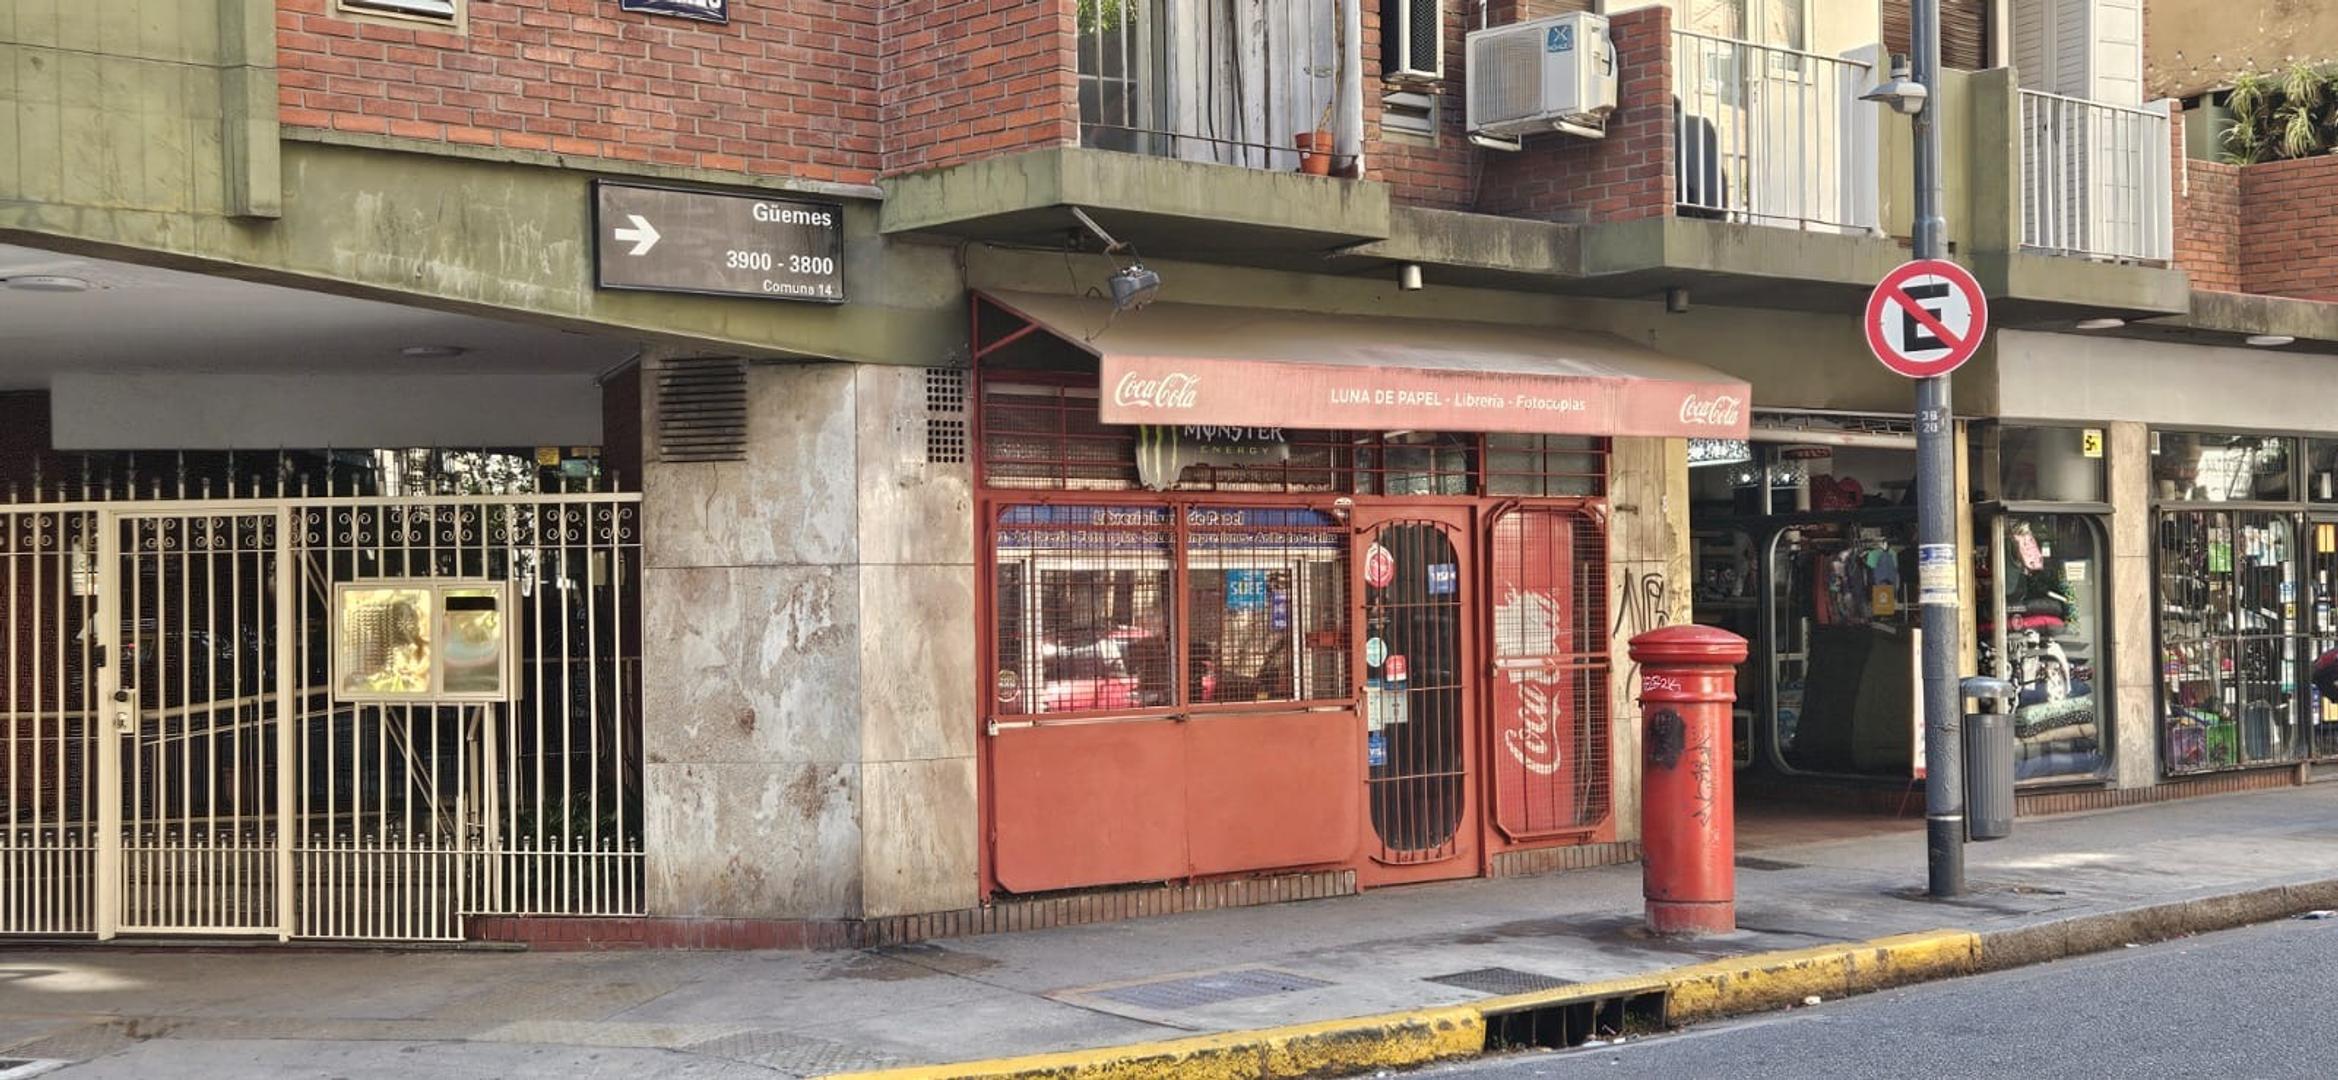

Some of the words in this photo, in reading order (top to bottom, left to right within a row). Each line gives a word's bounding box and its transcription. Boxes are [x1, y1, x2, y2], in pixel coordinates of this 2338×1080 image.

[753, 203, 832, 226] Güemes
[726, 250, 771, 271] 3900
[789, 255, 834, 275] 3800
[763, 279, 815, 295] Comuna
[818, 284, 832, 296] 14
[1330, 388, 1370, 404] LUNA
[1375, 389, 1394, 405] DE
[1398, 390, 1442, 406] PAPEL
